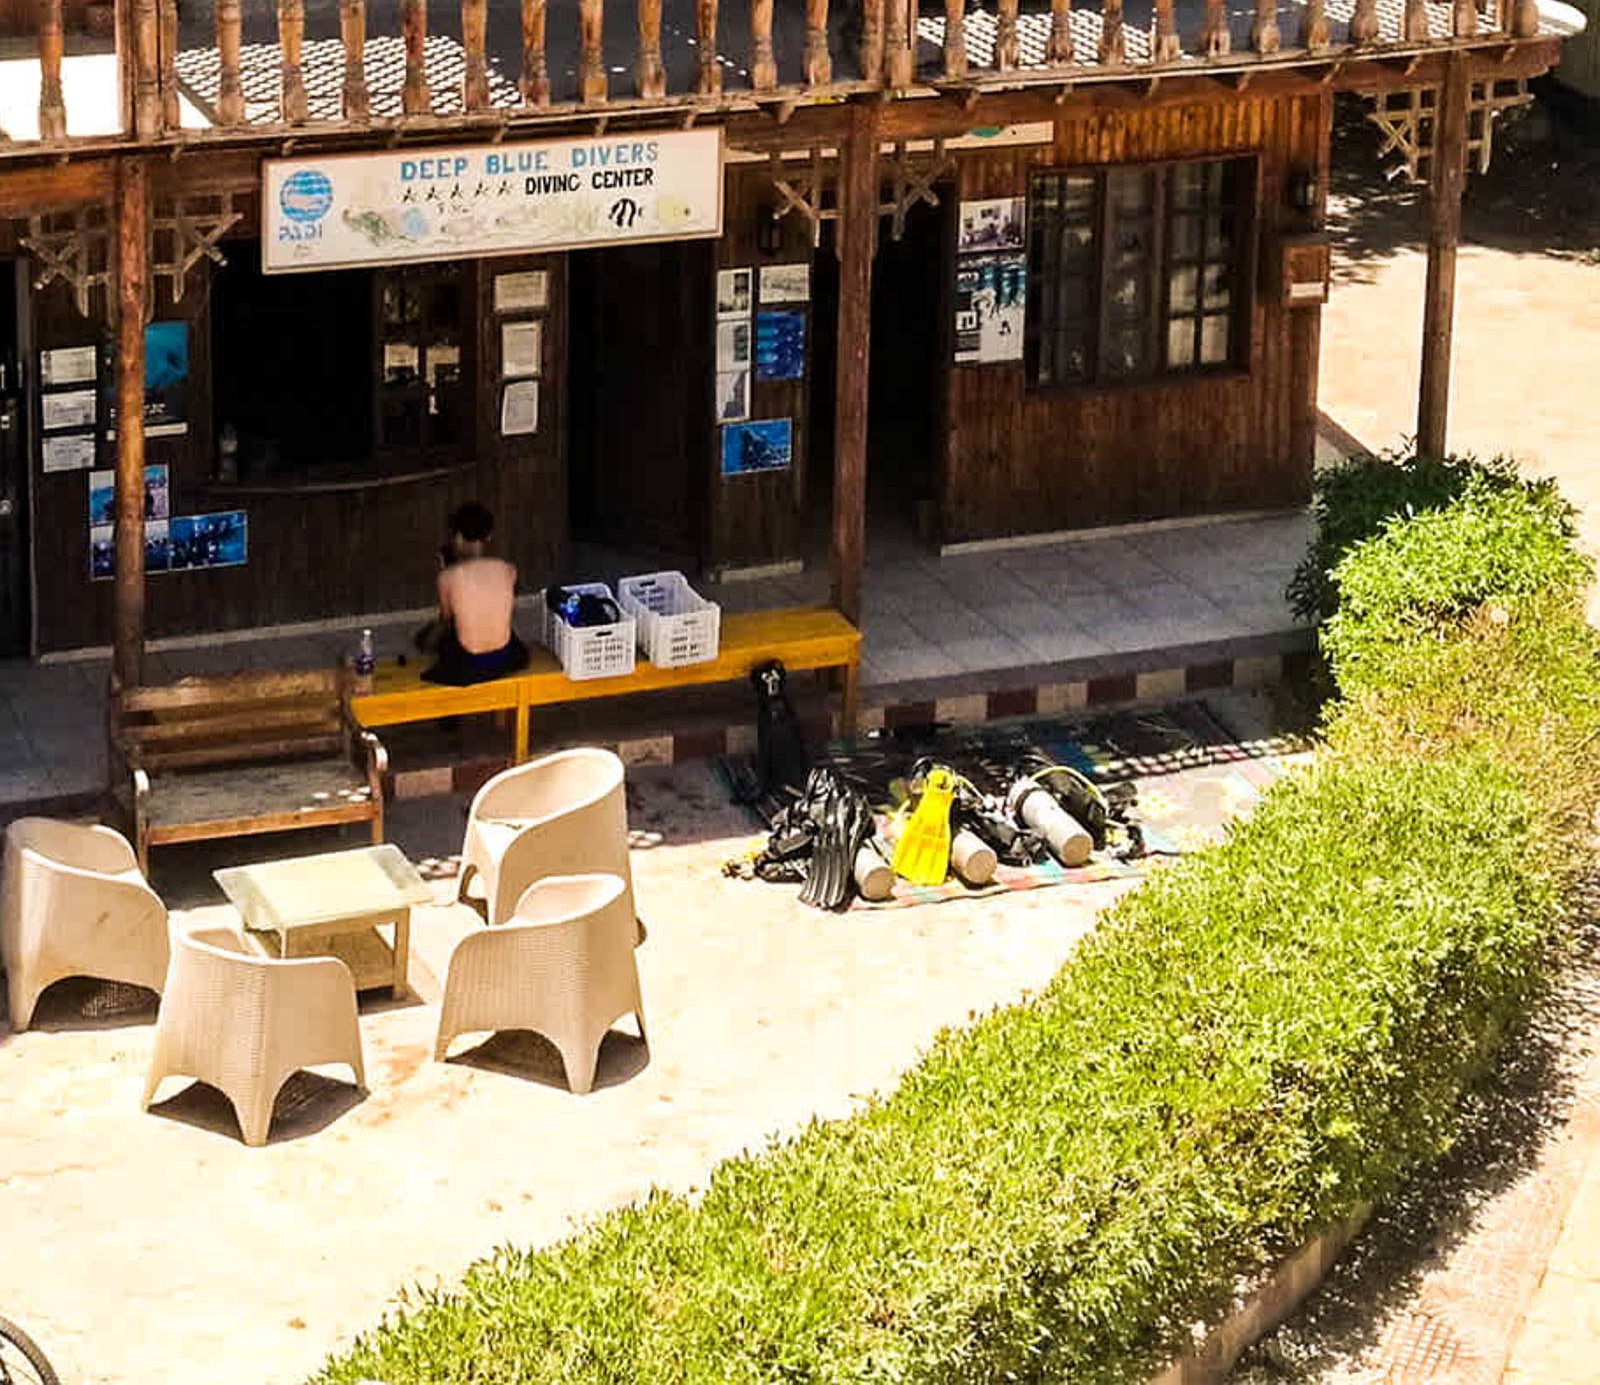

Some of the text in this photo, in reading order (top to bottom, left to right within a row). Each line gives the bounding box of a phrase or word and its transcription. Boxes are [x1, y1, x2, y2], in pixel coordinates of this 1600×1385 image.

[400, 142, 659, 181] DEEP BLUE DIVERS
[591, 167, 654, 189] CENTER
